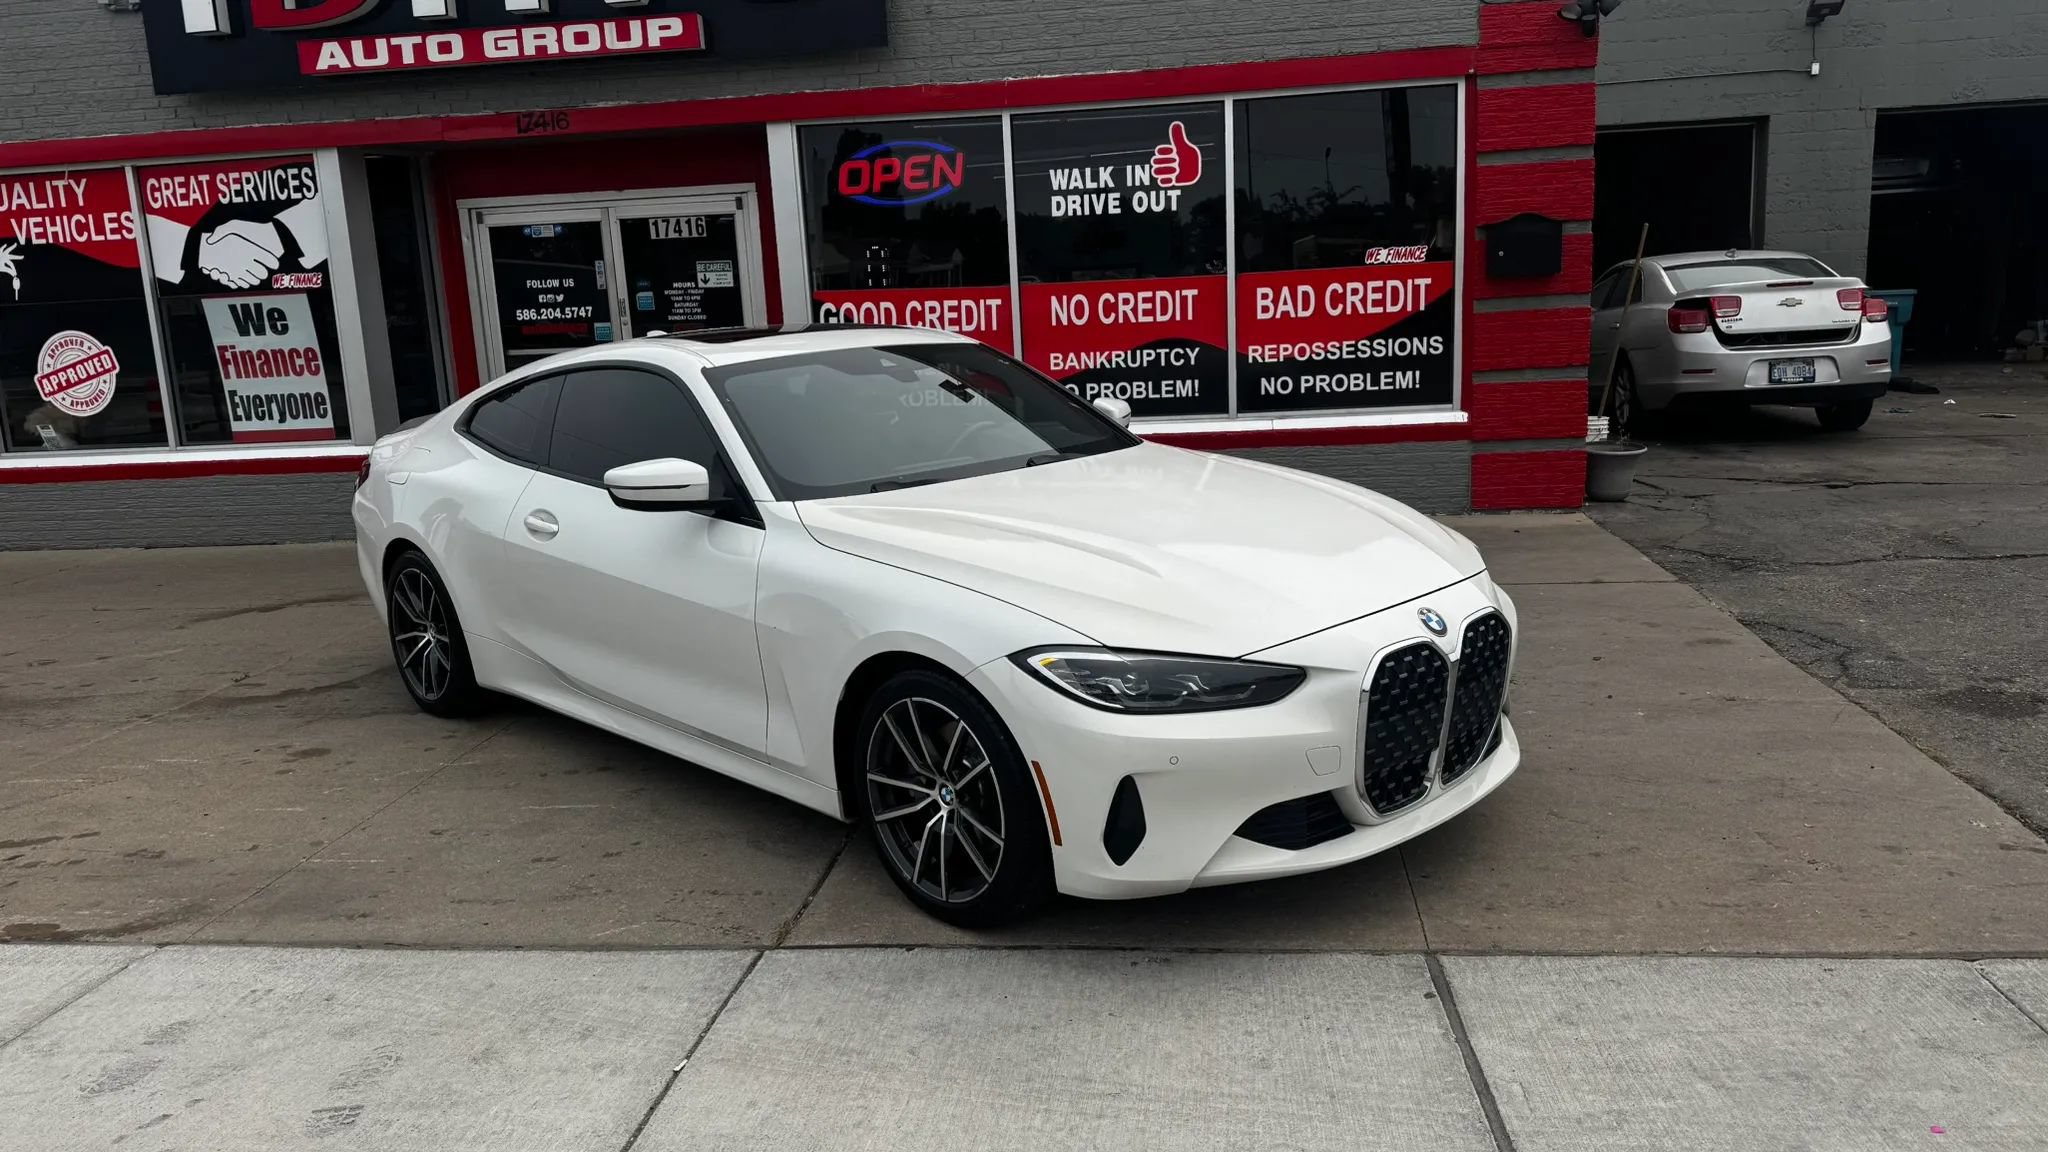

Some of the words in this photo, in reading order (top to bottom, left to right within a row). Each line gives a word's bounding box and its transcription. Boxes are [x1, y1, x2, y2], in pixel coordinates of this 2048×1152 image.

[315, 33, 464, 70] AUTO
[482, 17, 684, 58] GROUP
[516, 112, 570, 134] 17416
[838, 152, 964, 195] OPEN
[1049, 166, 1115, 190] WALK
[1126, 164, 1150, 186] IN
[146, 174, 211, 209] GREAT
[216, 167, 315, 204] SERVICES
[1051, 192, 1121, 217] DRIVE
[1132, 189, 1181, 213] OUT
[10, 211, 137, 245] VEHICLES
[651, 217, 705, 238] 17416
[1366, 247, 1382, 263] WE
[1385, 245, 1428, 263] FINANCE
[272, 274, 286, 288] WE
[288, 272, 322, 288] FINANCE
[526, 279, 559, 288] FOLLOW
[563, 278, 575, 287] US
[1051, 294, 1089, 326] NO
[1098, 289, 1198, 325] CREDIT
[1256, 284, 1316, 319] BAD
[1324, 277, 1431, 316] CREDIT
[227, 302, 290, 337] We
[516, 306, 593, 321] 586.204.5747
[819, 302, 897, 326] GOOD
[906, 299, 1002, 332] CREDIT
[48, 338, 85, 360] APPROVED
[217, 345, 321, 379] Finance
[1050, 347, 1200, 370] BANKRUPTCY
[1248, 335, 1444, 363] REPOSSESSIONS
[41, 354, 113, 394] APPROVED
[1260, 376, 1293, 395] NO
[1300, 370, 1421, 393] PROBLEM!
[70, 388, 105, 408] APPROVED
[1086, 379, 1200, 401] PROBLEM!
[228, 390, 328, 424] Everyone
